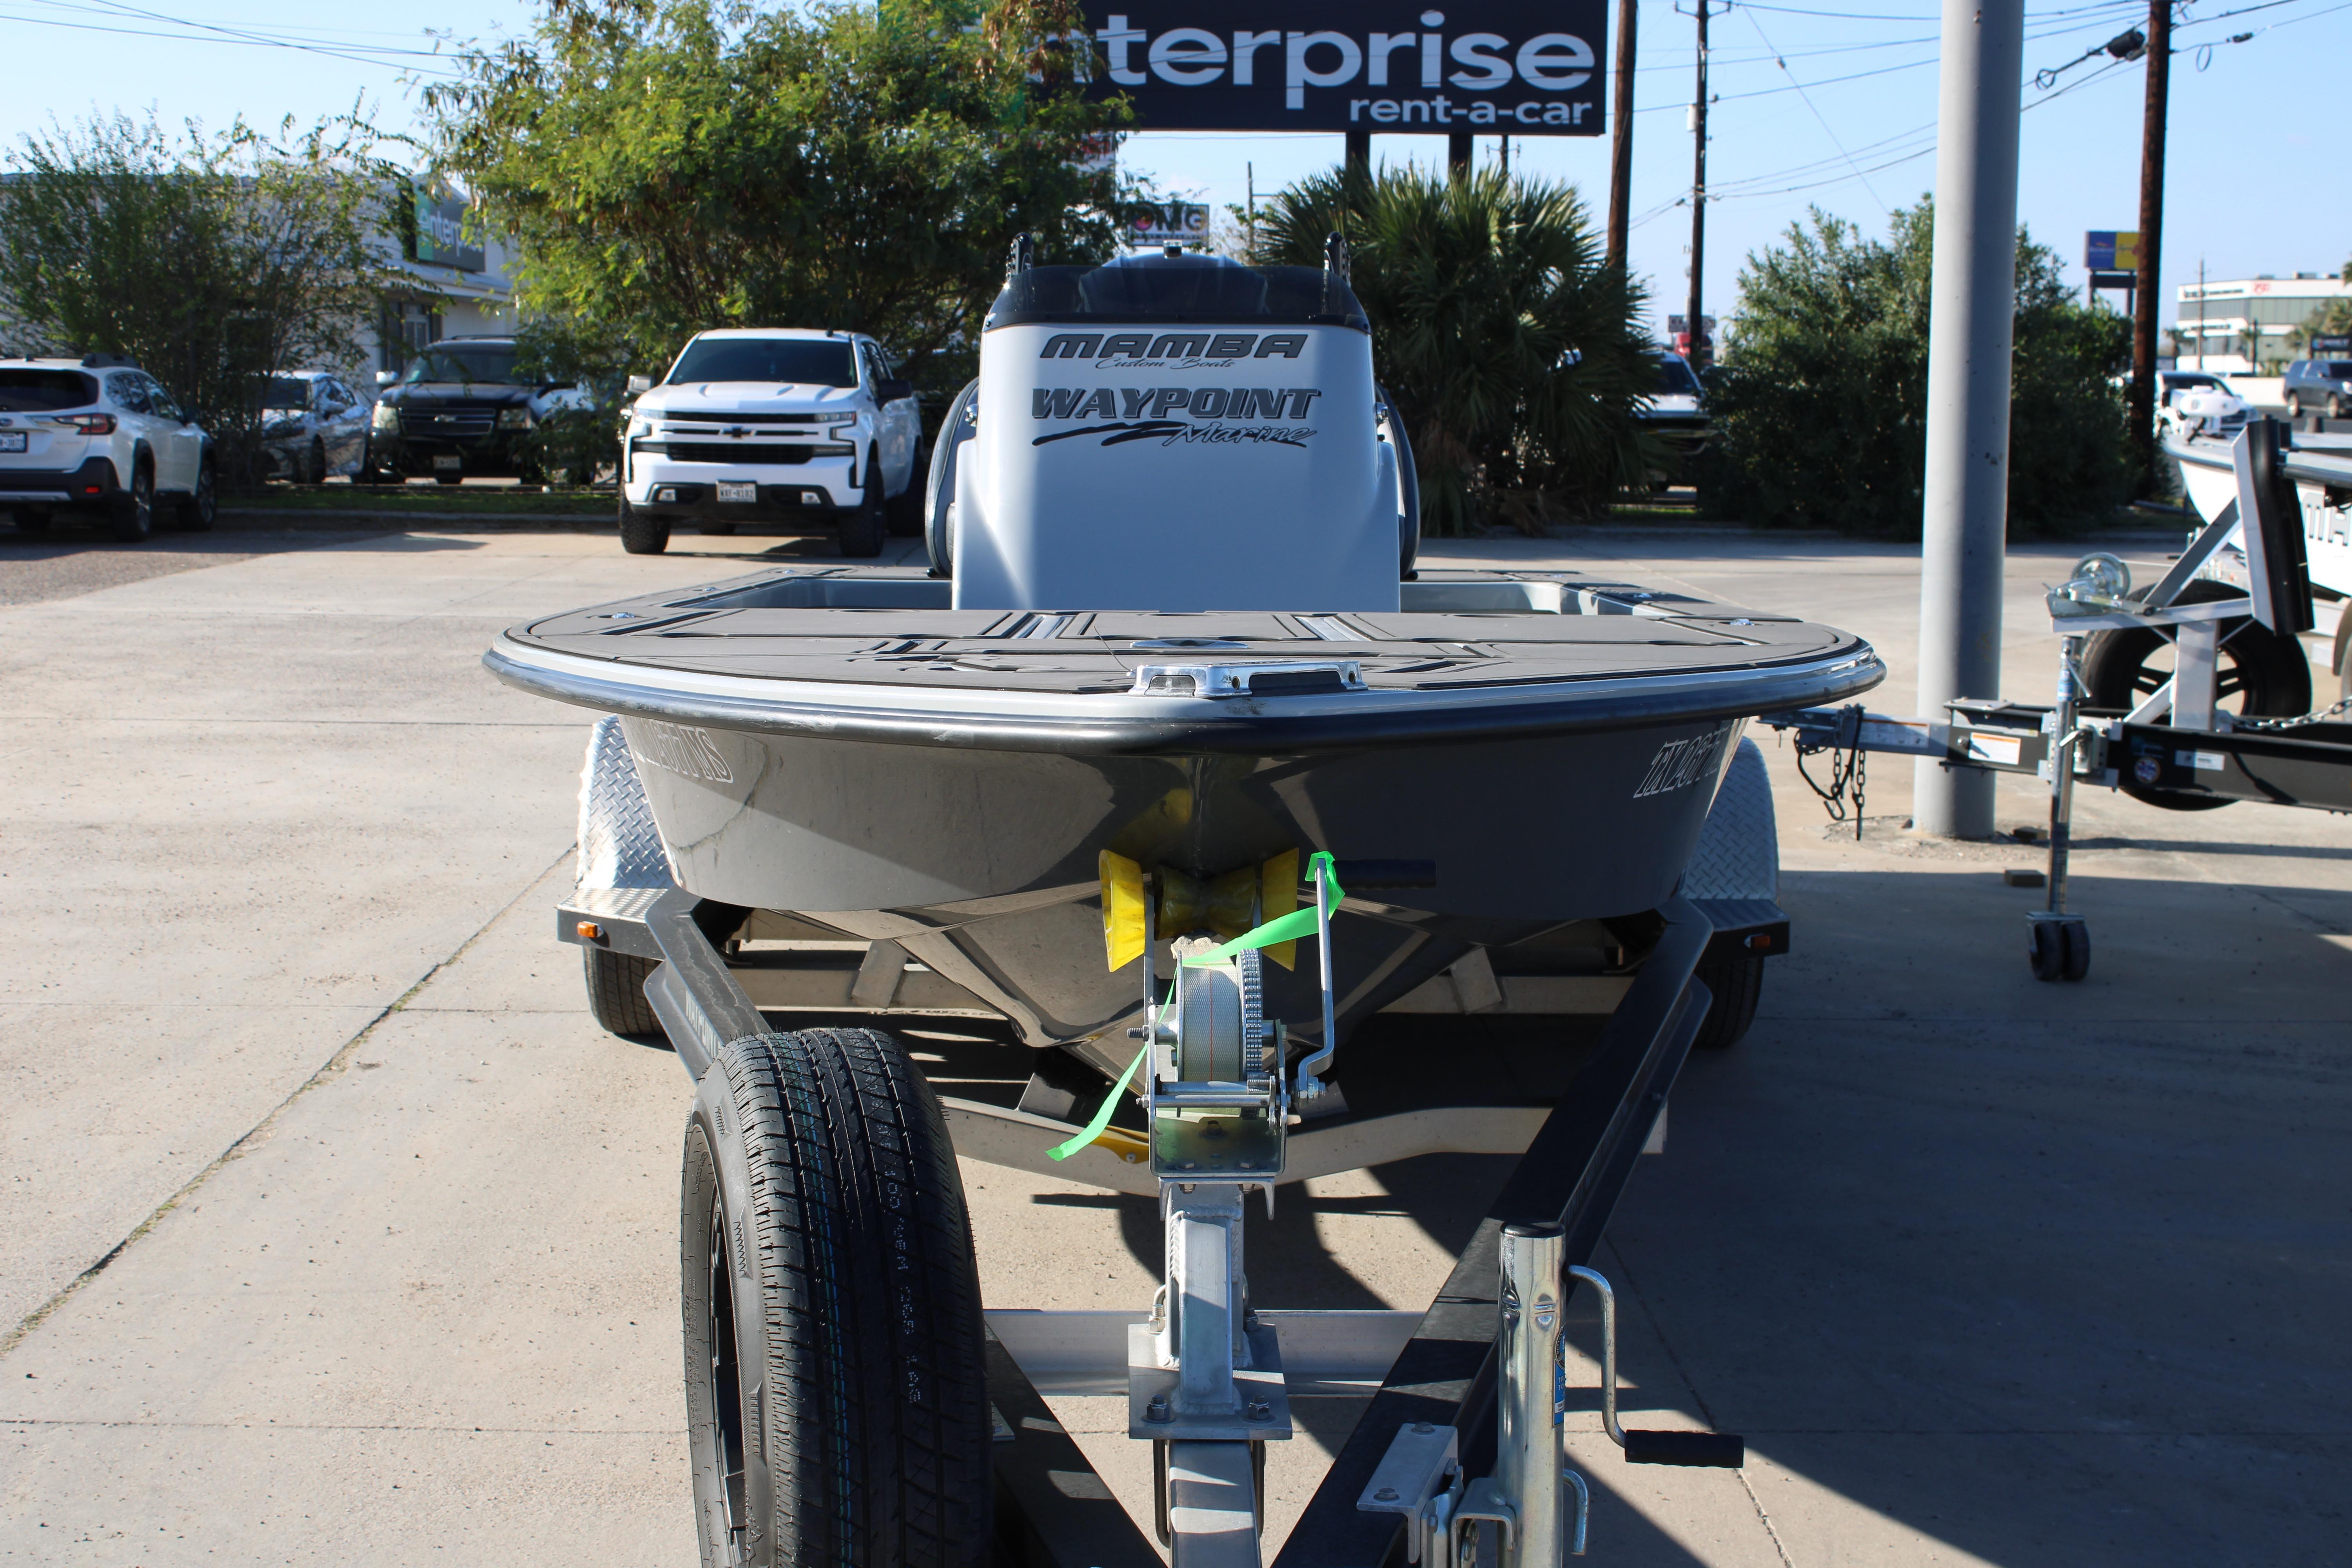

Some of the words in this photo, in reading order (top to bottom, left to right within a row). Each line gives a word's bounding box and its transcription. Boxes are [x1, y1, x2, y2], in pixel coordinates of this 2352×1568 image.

[1350, 94, 1592, 125] rent-a-car
[1039, 334, 1308, 359] MAMBA
[1095, 357, 1165, 370] Custom
[1171, 357, 1236, 370] Boats
[1032, 387, 1322, 420] WAYPOINT
[1162, 421, 1318, 447] Marine
[1633, 738, 1689, 799] TX
